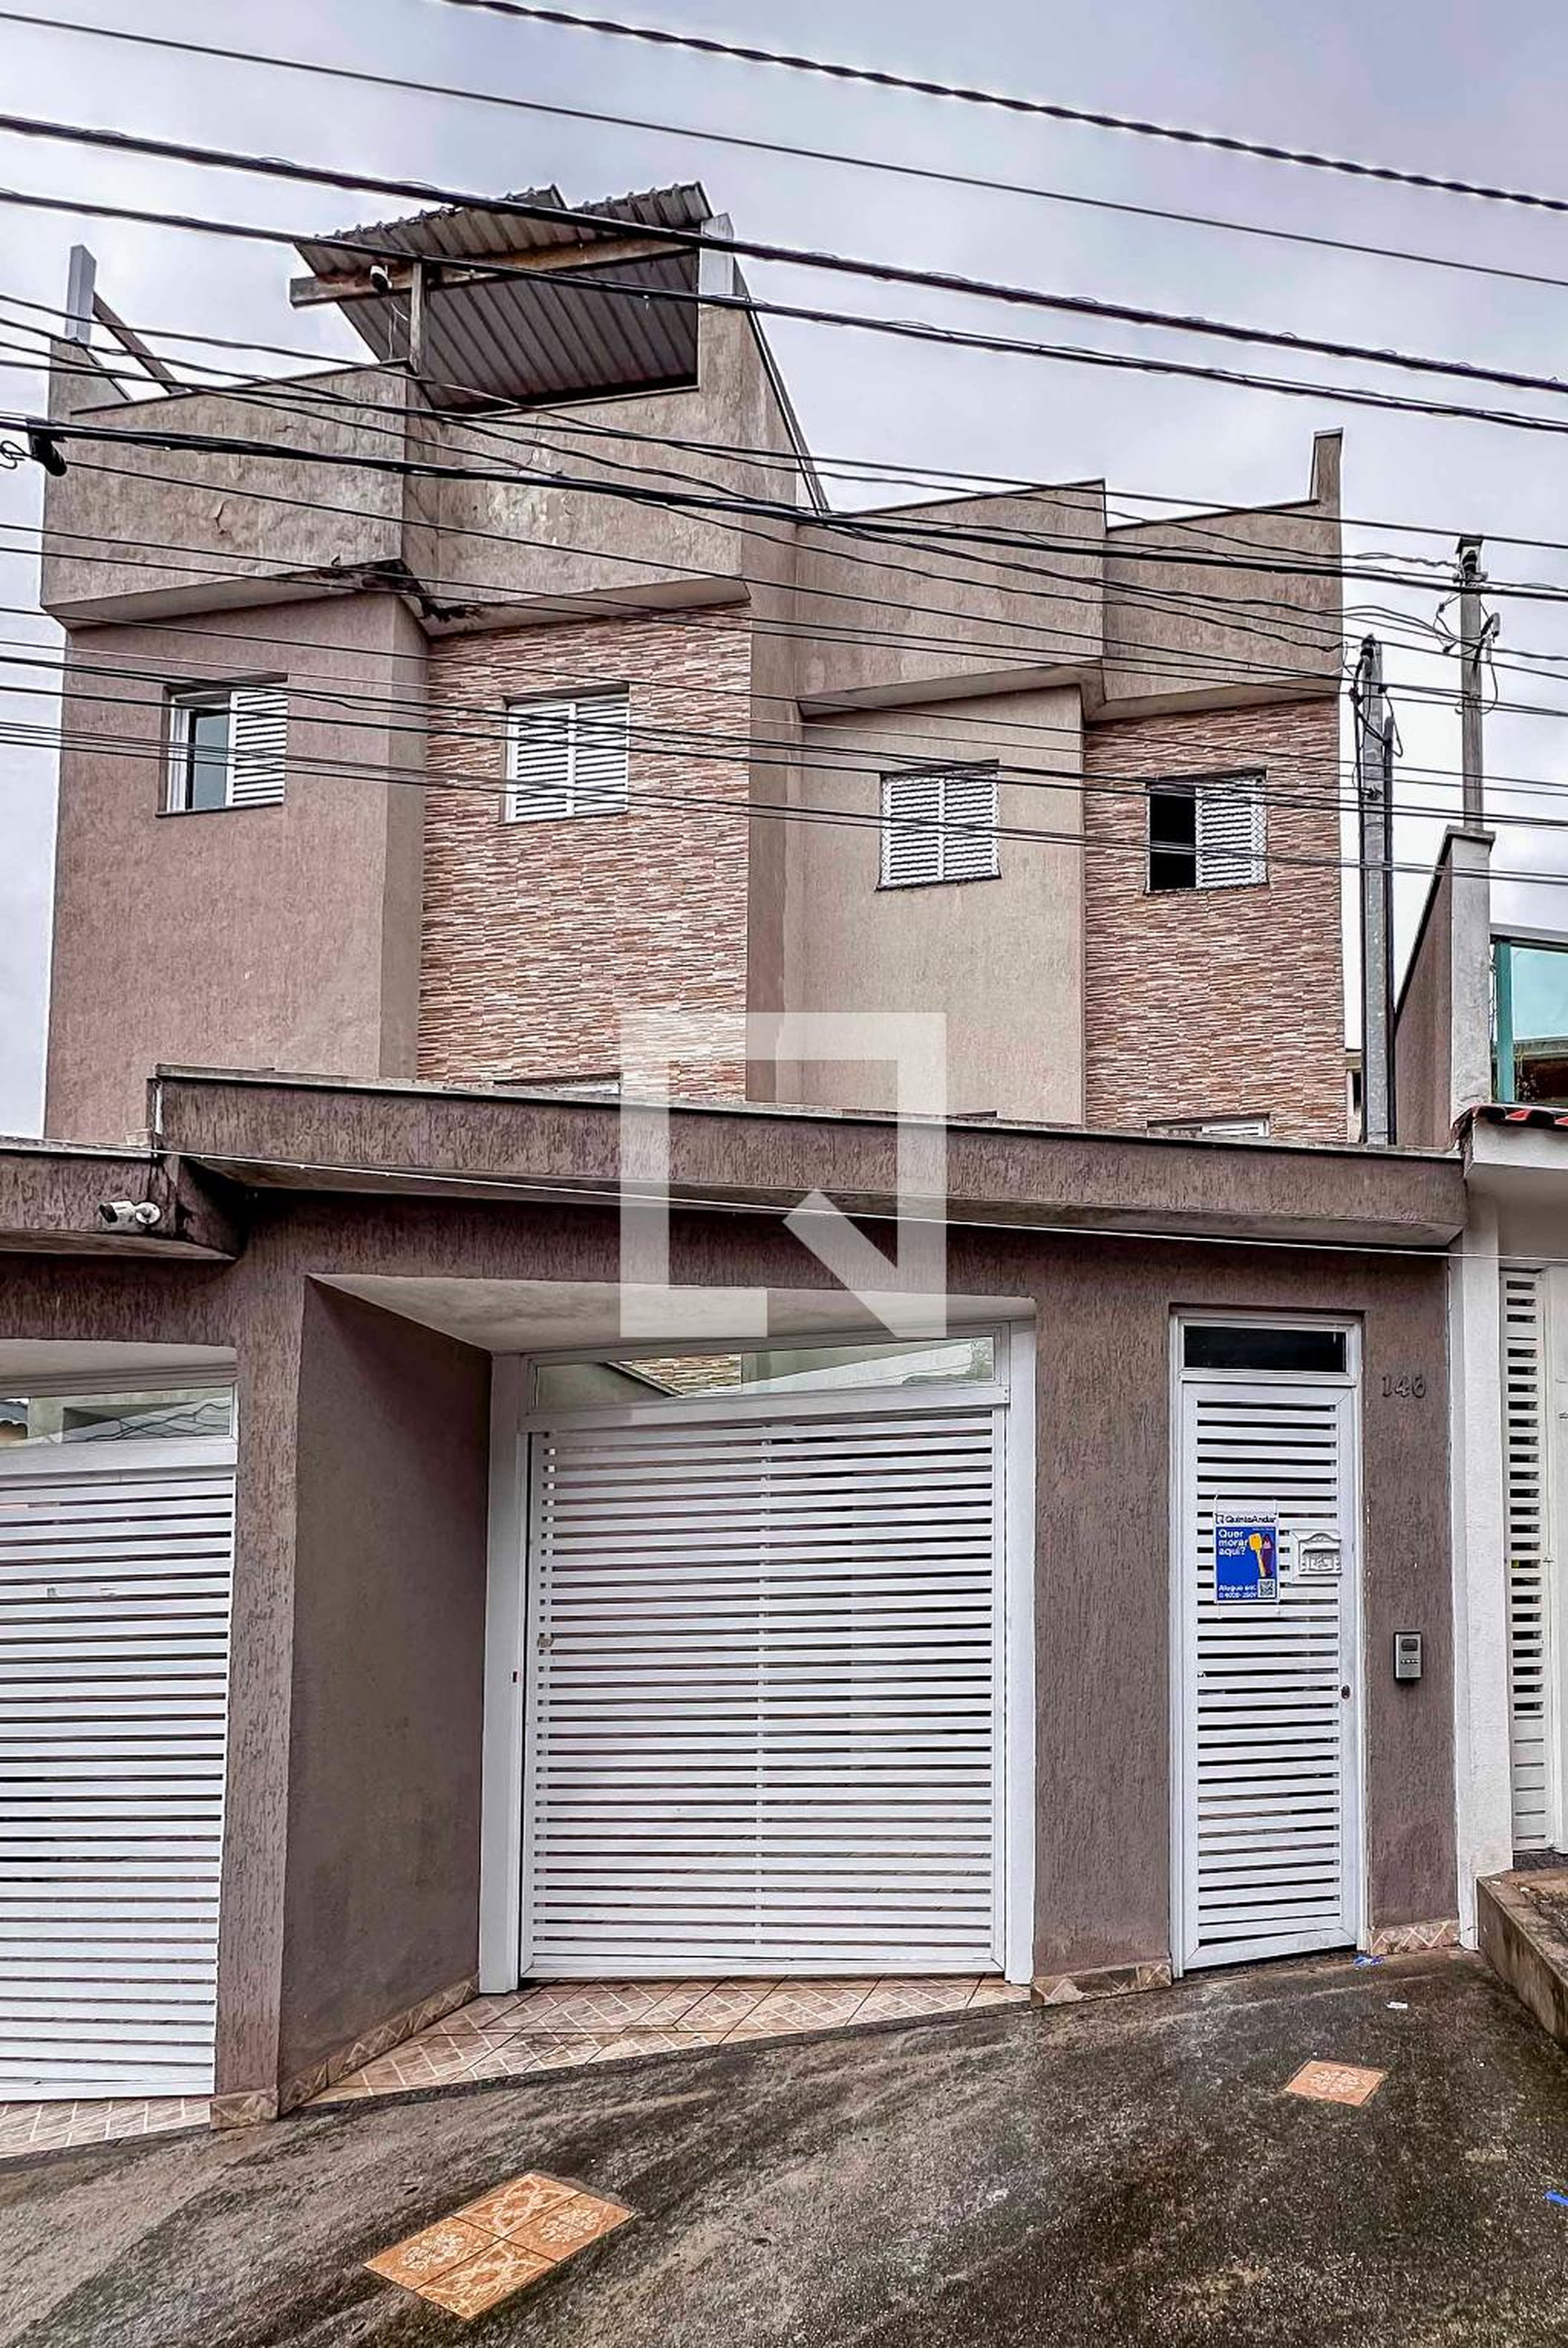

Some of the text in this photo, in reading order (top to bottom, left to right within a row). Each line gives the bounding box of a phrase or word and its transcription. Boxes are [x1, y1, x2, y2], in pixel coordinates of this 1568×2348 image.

[1382, 1374, 1426, 1398] 146
[1218, 1529, 1243, 1538] Quer
[1218, 1547, 1245, 1556] aqui?
